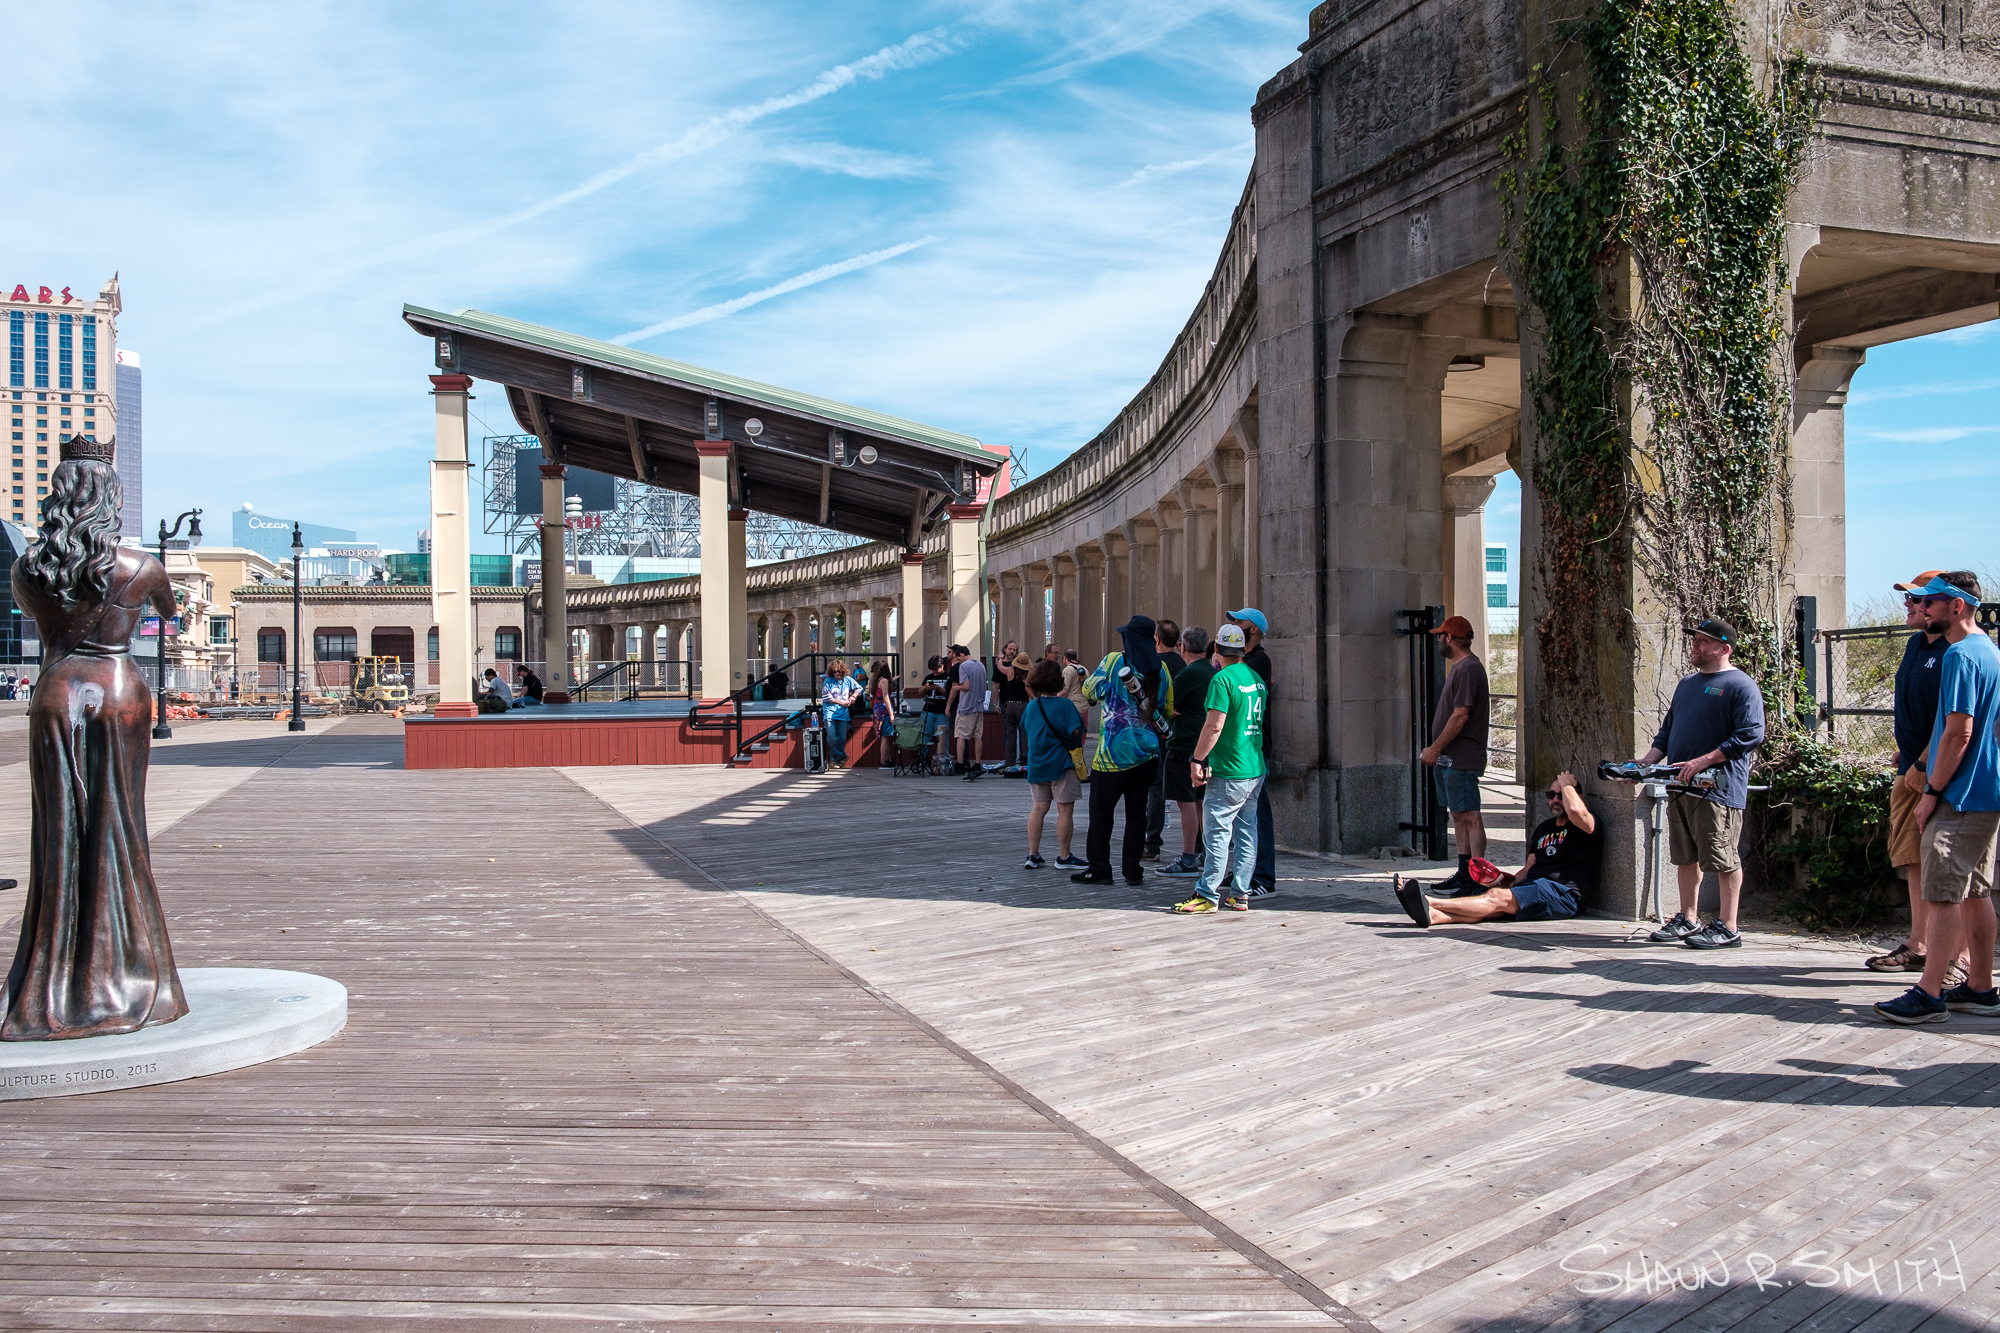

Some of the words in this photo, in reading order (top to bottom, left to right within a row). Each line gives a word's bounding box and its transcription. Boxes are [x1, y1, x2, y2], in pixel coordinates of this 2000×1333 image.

[0, 284, 74, 305] ARS
[248, 516, 291, 530] Ocean
[330, 549, 355, 557] HARD
[357, 549, 380, 558] ROCK
[1246, 695, 1262, 721] 14
[0, 1073, 57, 1088] ULPTURE
[65, 1068, 119, 1083] STUDIO,
[127, 1063, 157, 1077] 2013
